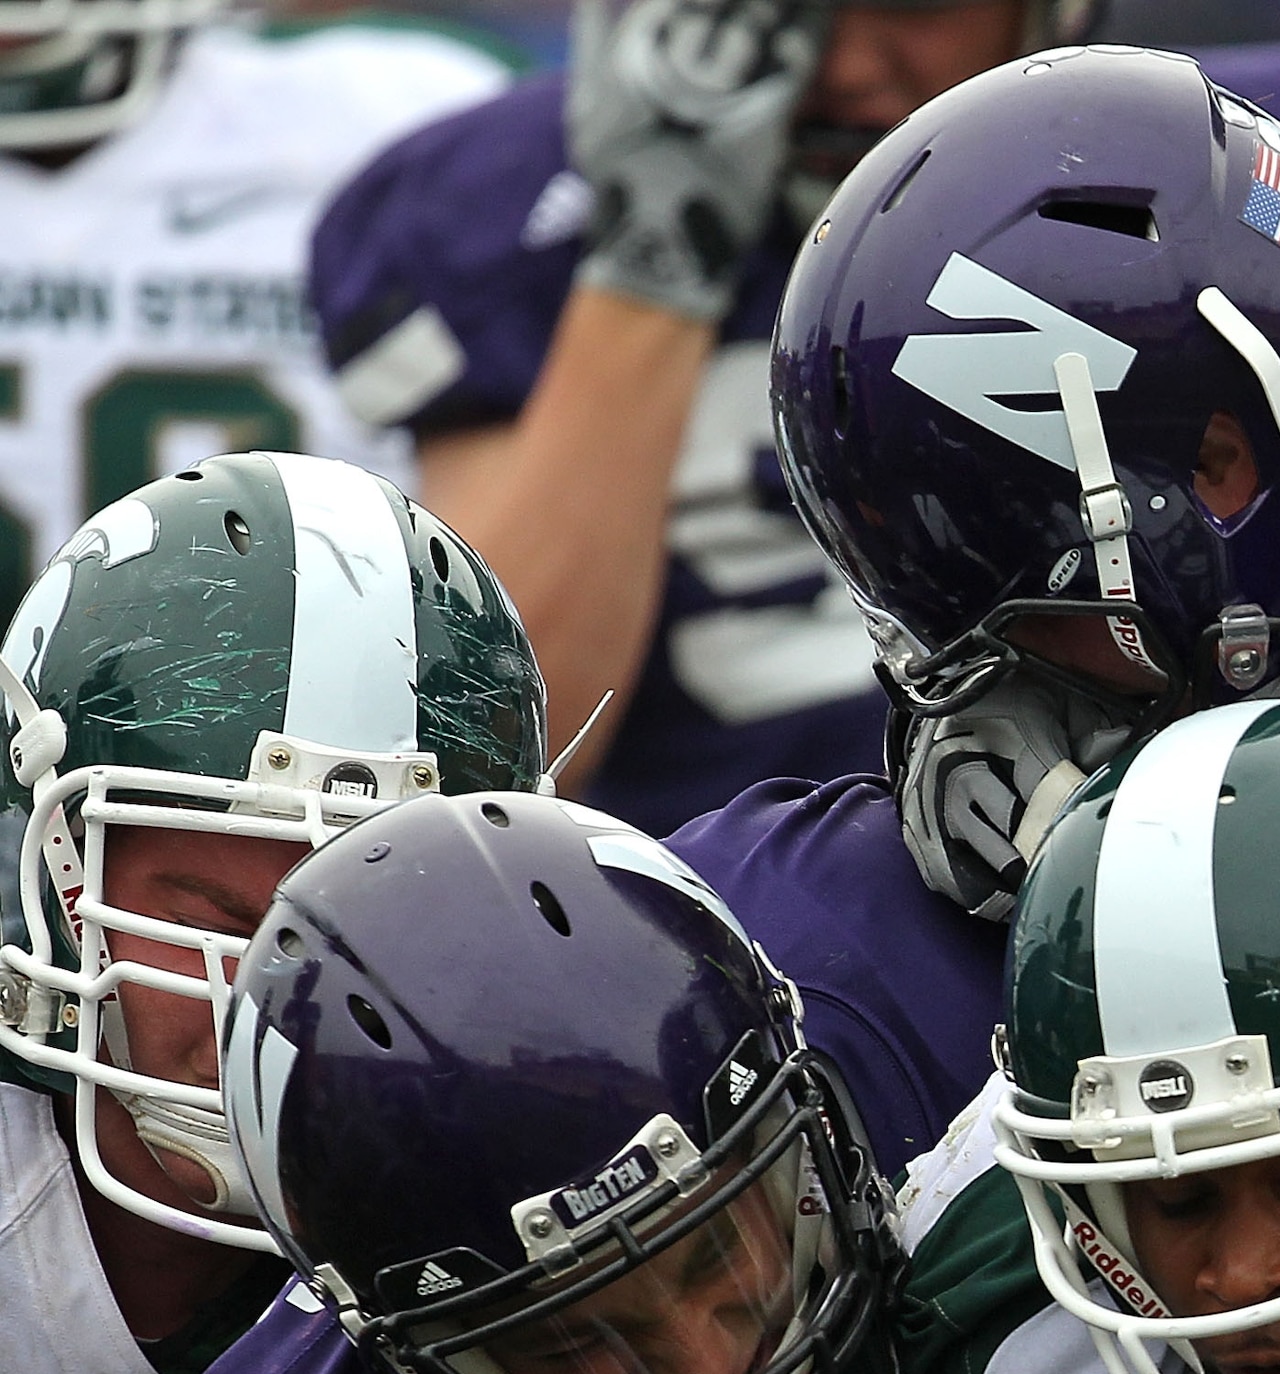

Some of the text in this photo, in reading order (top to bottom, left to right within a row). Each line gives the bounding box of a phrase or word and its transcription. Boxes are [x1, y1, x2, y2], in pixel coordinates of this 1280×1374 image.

[1051, 550, 1080, 590] SPEED
[329, 778, 376, 799] MSU
[729, 1068, 758, 1106] adidas
[416, 1276, 464, 1296] adidas
